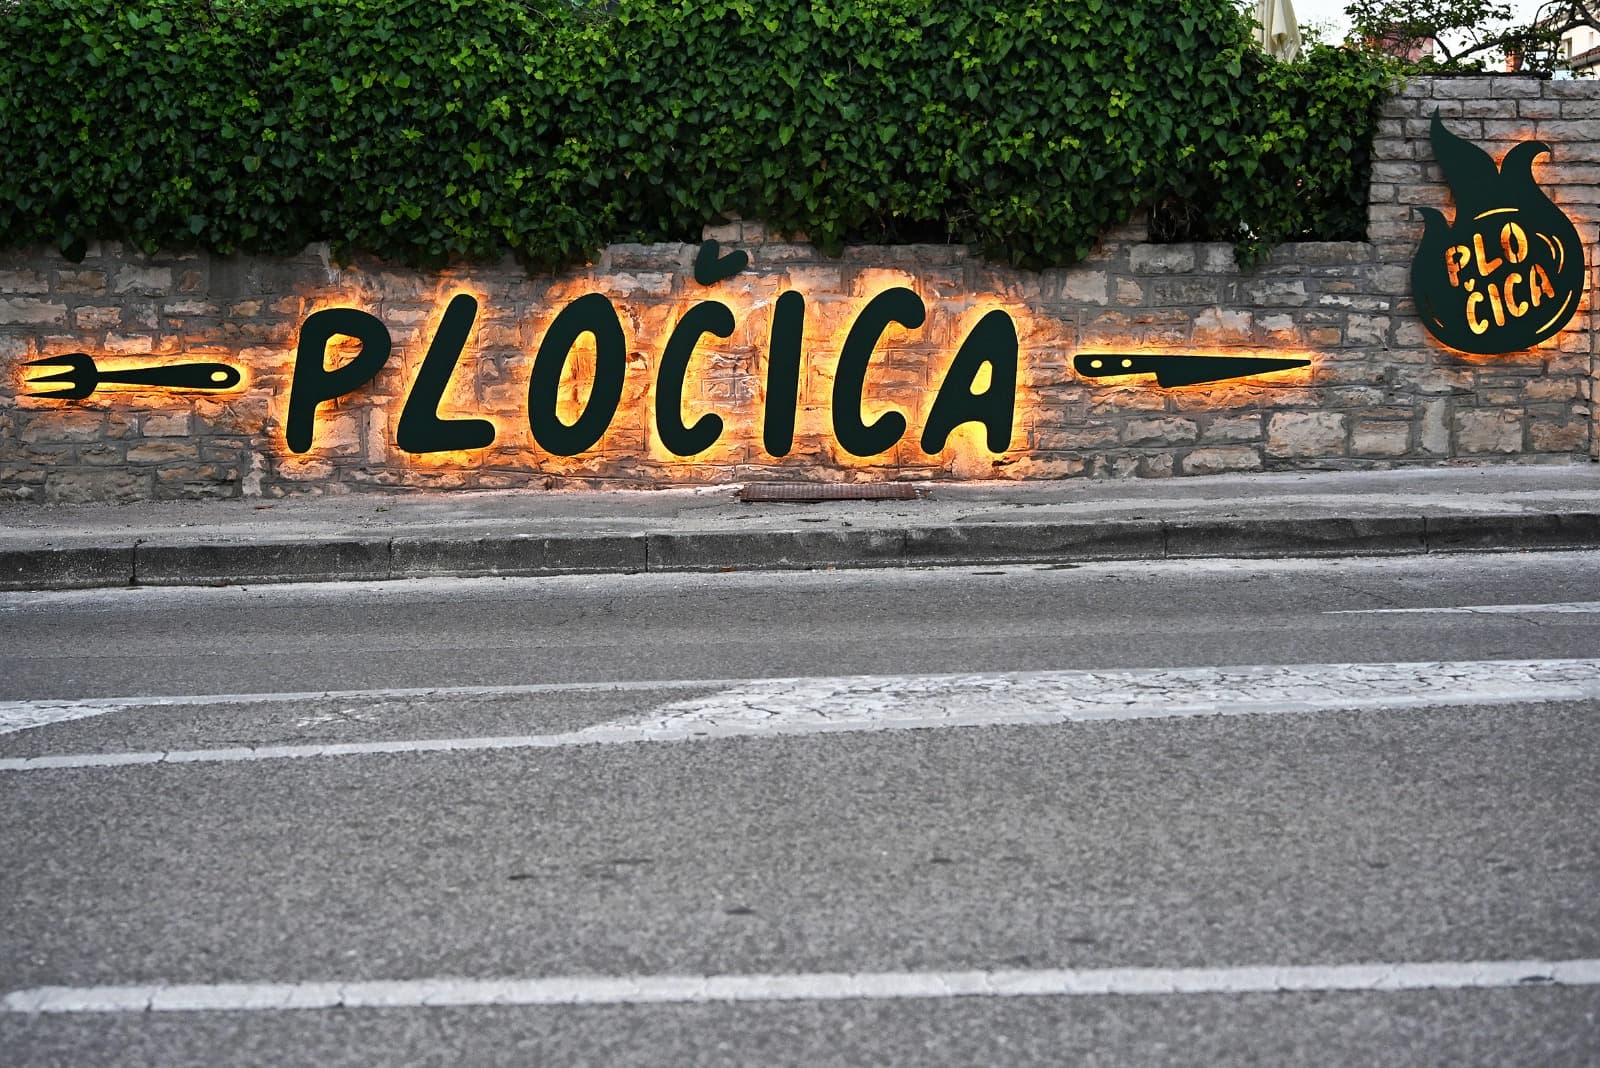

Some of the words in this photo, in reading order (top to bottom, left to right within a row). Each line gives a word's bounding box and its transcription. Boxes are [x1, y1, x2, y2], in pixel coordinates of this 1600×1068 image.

[1444, 222, 1528, 287] PLO
[1464, 264, 1555, 334] ČICA
[286, 239, 1018, 457] PLOČICA
